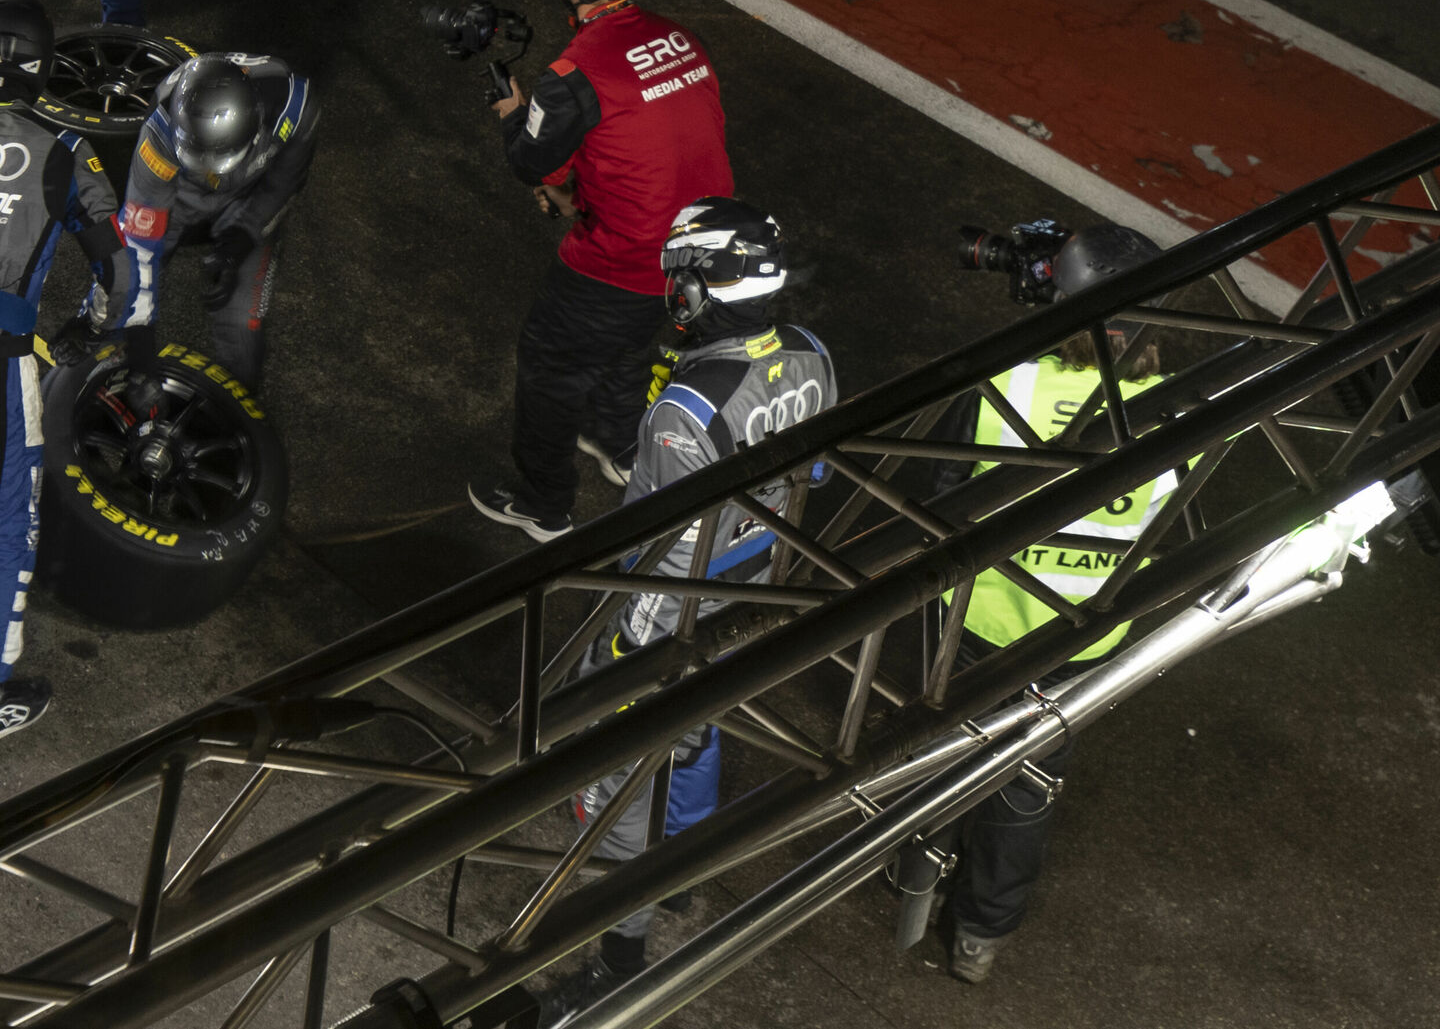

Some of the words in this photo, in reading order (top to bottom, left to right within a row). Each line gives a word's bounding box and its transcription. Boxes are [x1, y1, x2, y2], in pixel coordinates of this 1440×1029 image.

[626, 32, 690, 71] SRO
[641, 78, 684, 102] MEDIA
[682, 65, 709, 84] TEAM
[65, 464, 179, 547] PIRELLI
[1021, 549, 1049, 565] IT
